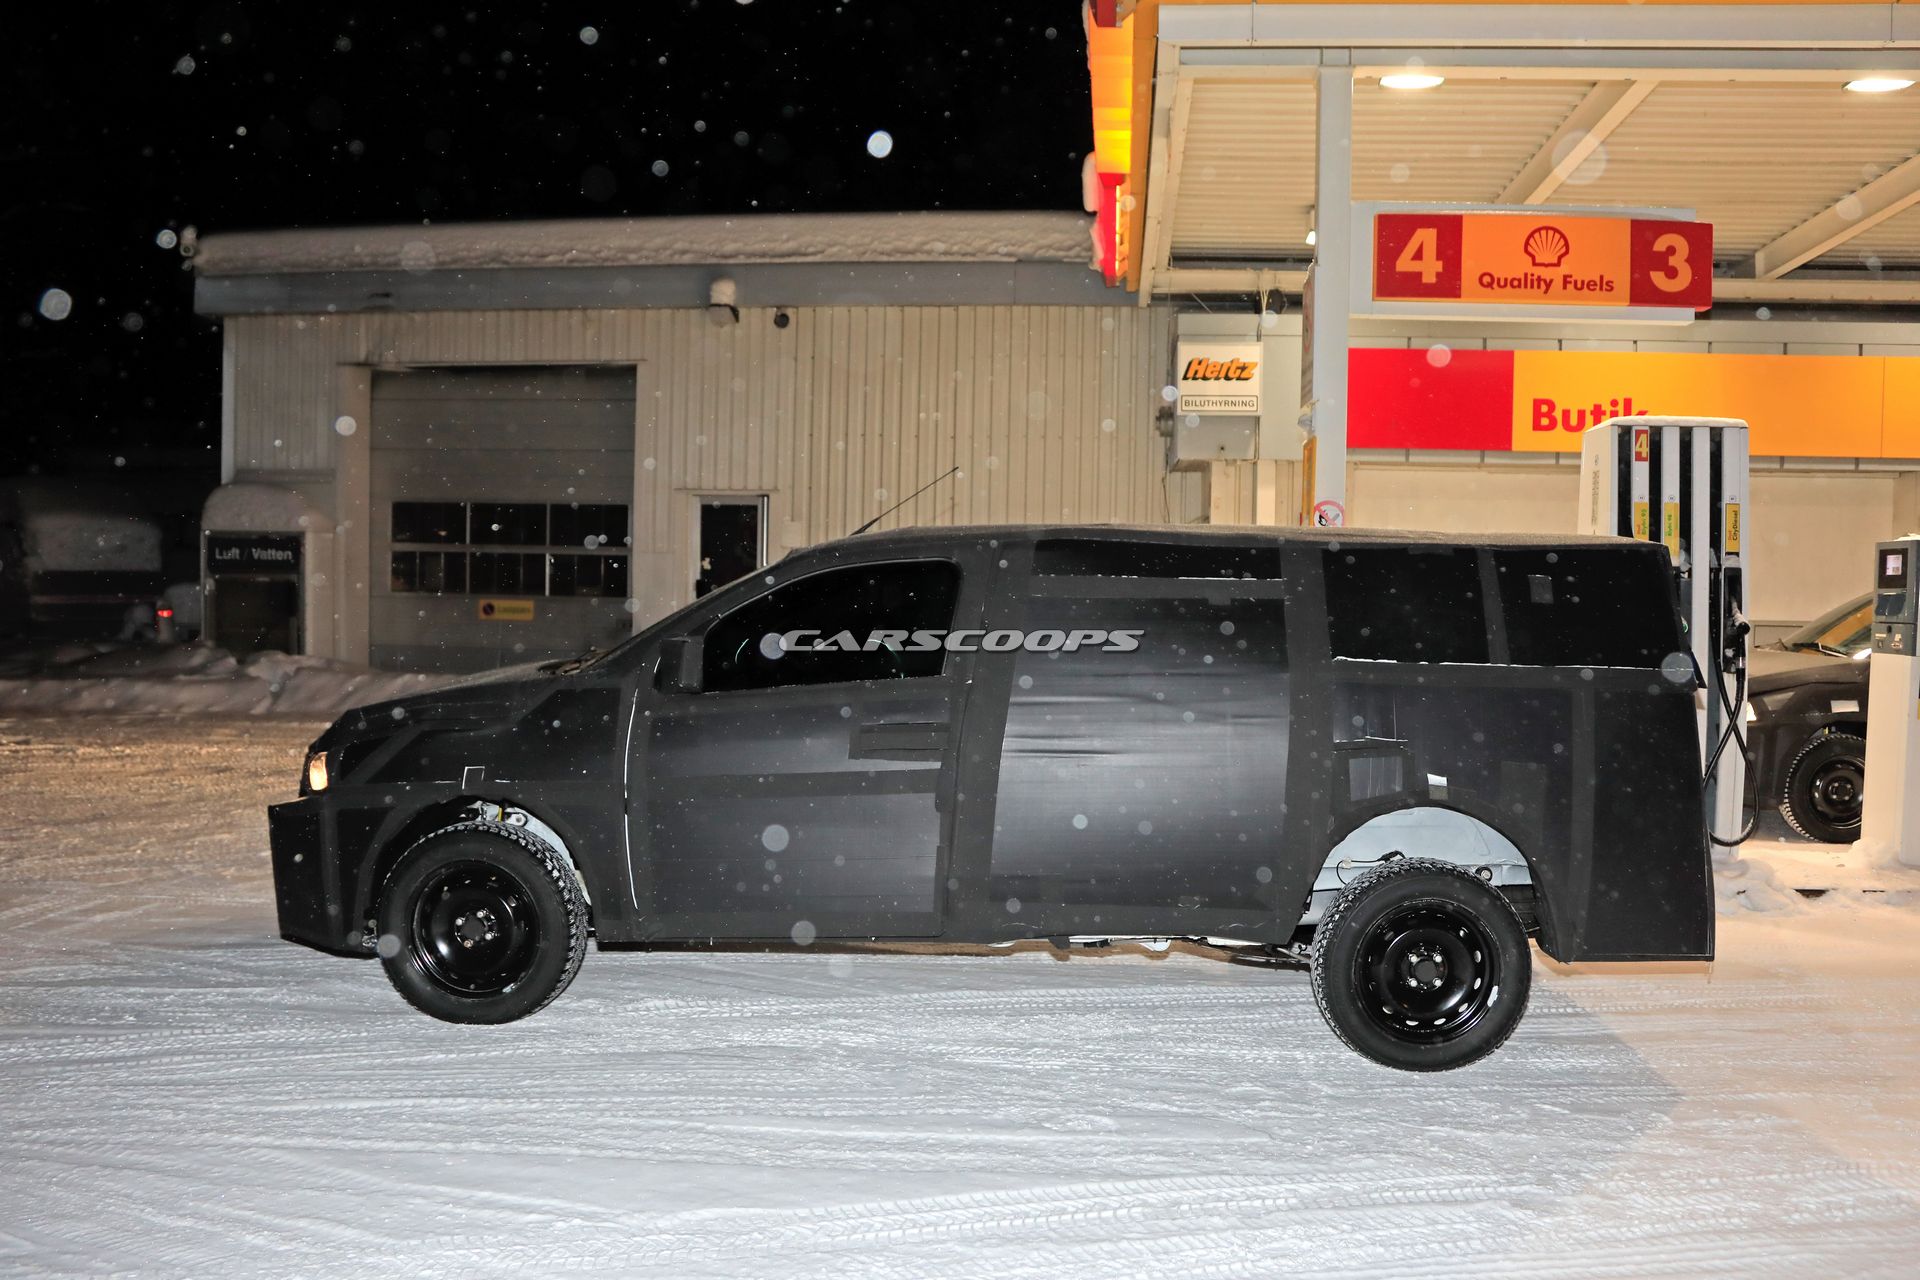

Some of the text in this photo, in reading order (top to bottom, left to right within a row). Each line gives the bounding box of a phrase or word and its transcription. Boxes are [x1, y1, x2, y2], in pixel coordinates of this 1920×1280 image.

[1395, 228, 1443, 284] 4
[1650, 233, 1692, 292] 3
[1478, 272, 1615, 294] Quality Fuels
[1182, 357, 1259, 381] Hertz
[1184, 399, 1255, 408] BILUTHYRNING
[1635, 433, 1648, 458] 4
